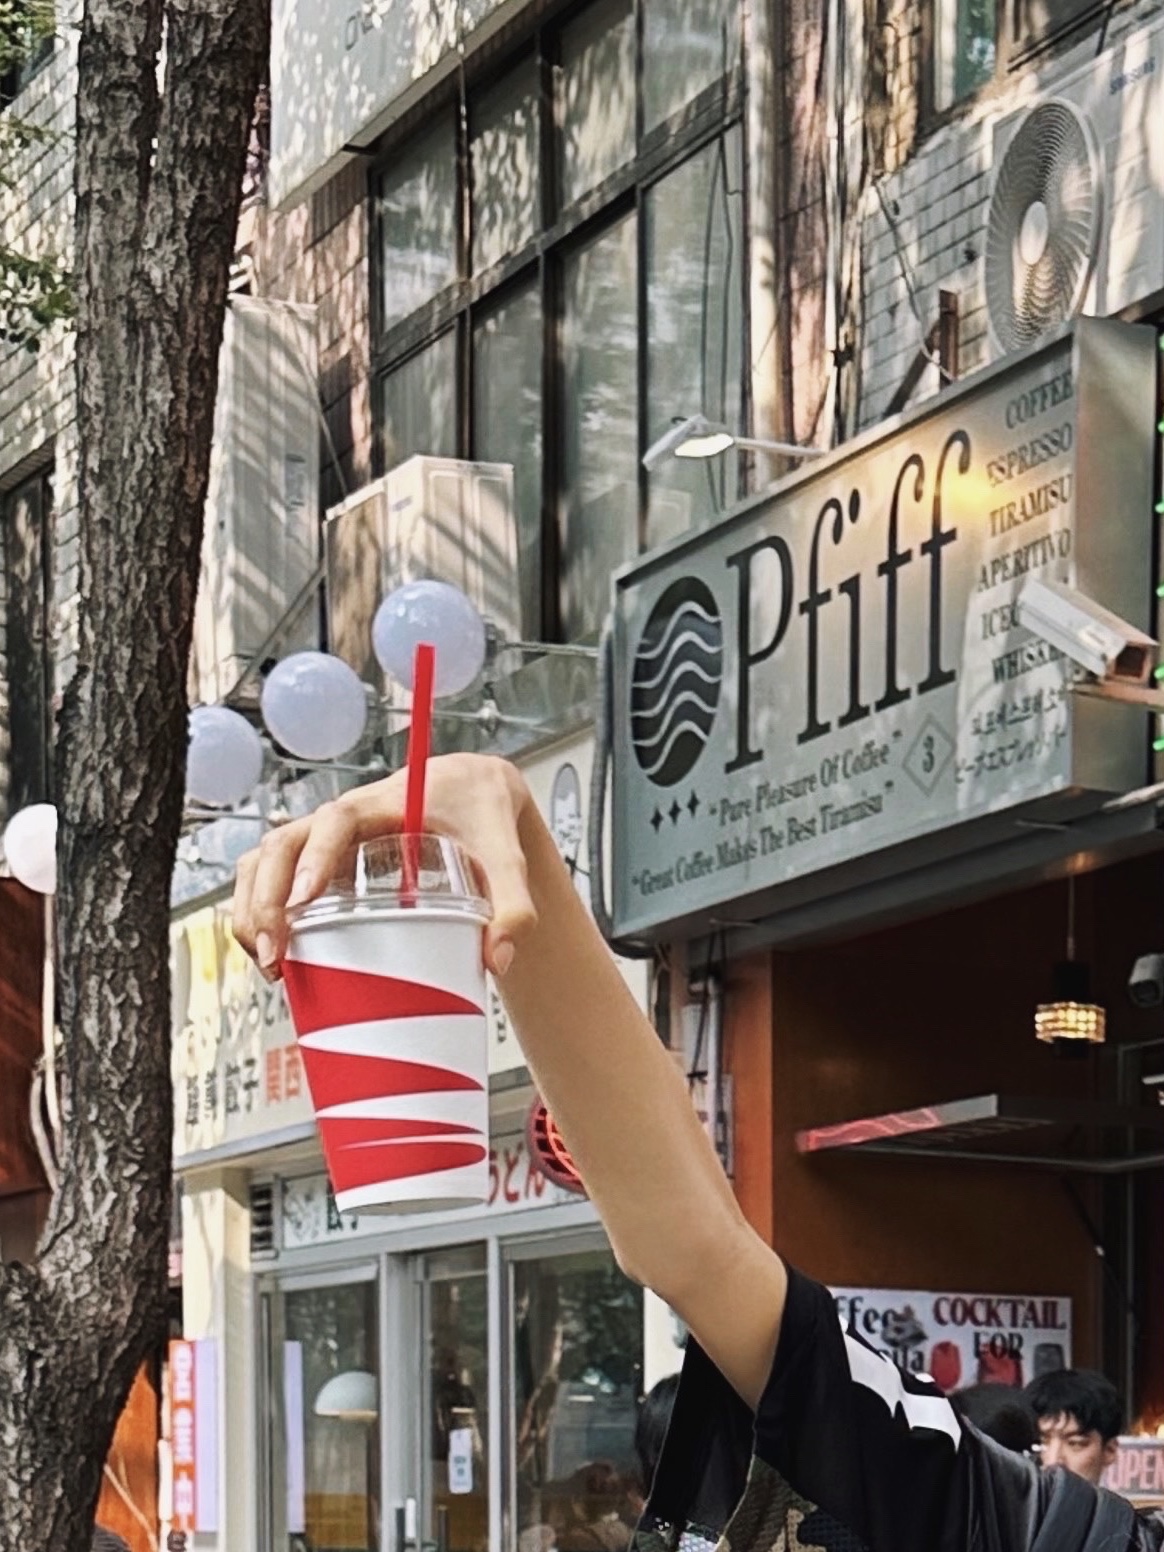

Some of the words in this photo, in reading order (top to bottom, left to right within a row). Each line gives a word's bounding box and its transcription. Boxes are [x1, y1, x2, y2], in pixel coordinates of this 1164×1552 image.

[1006, 369, 1074, 429] COFFEE
[986, 422, 1073, 487] ESPRESSO
[989, 474, 1073, 537] TIRAMISU
[976, 528, 1071, 593] APERITIVO
[725, 428, 970, 773] Pfiff
[757, 772, 817, 813] Pleasure
[820, 755, 841, 788] Of
[923, 735, 934, 773] 3
[676, 851, 714, 884] Coffee
[760, 825, 784, 857] The
[787, 815, 817, 847] Best
[932, 1297, 1066, 1330] COCKTAIL
[974, 1330, 1024, 1360] FOR
